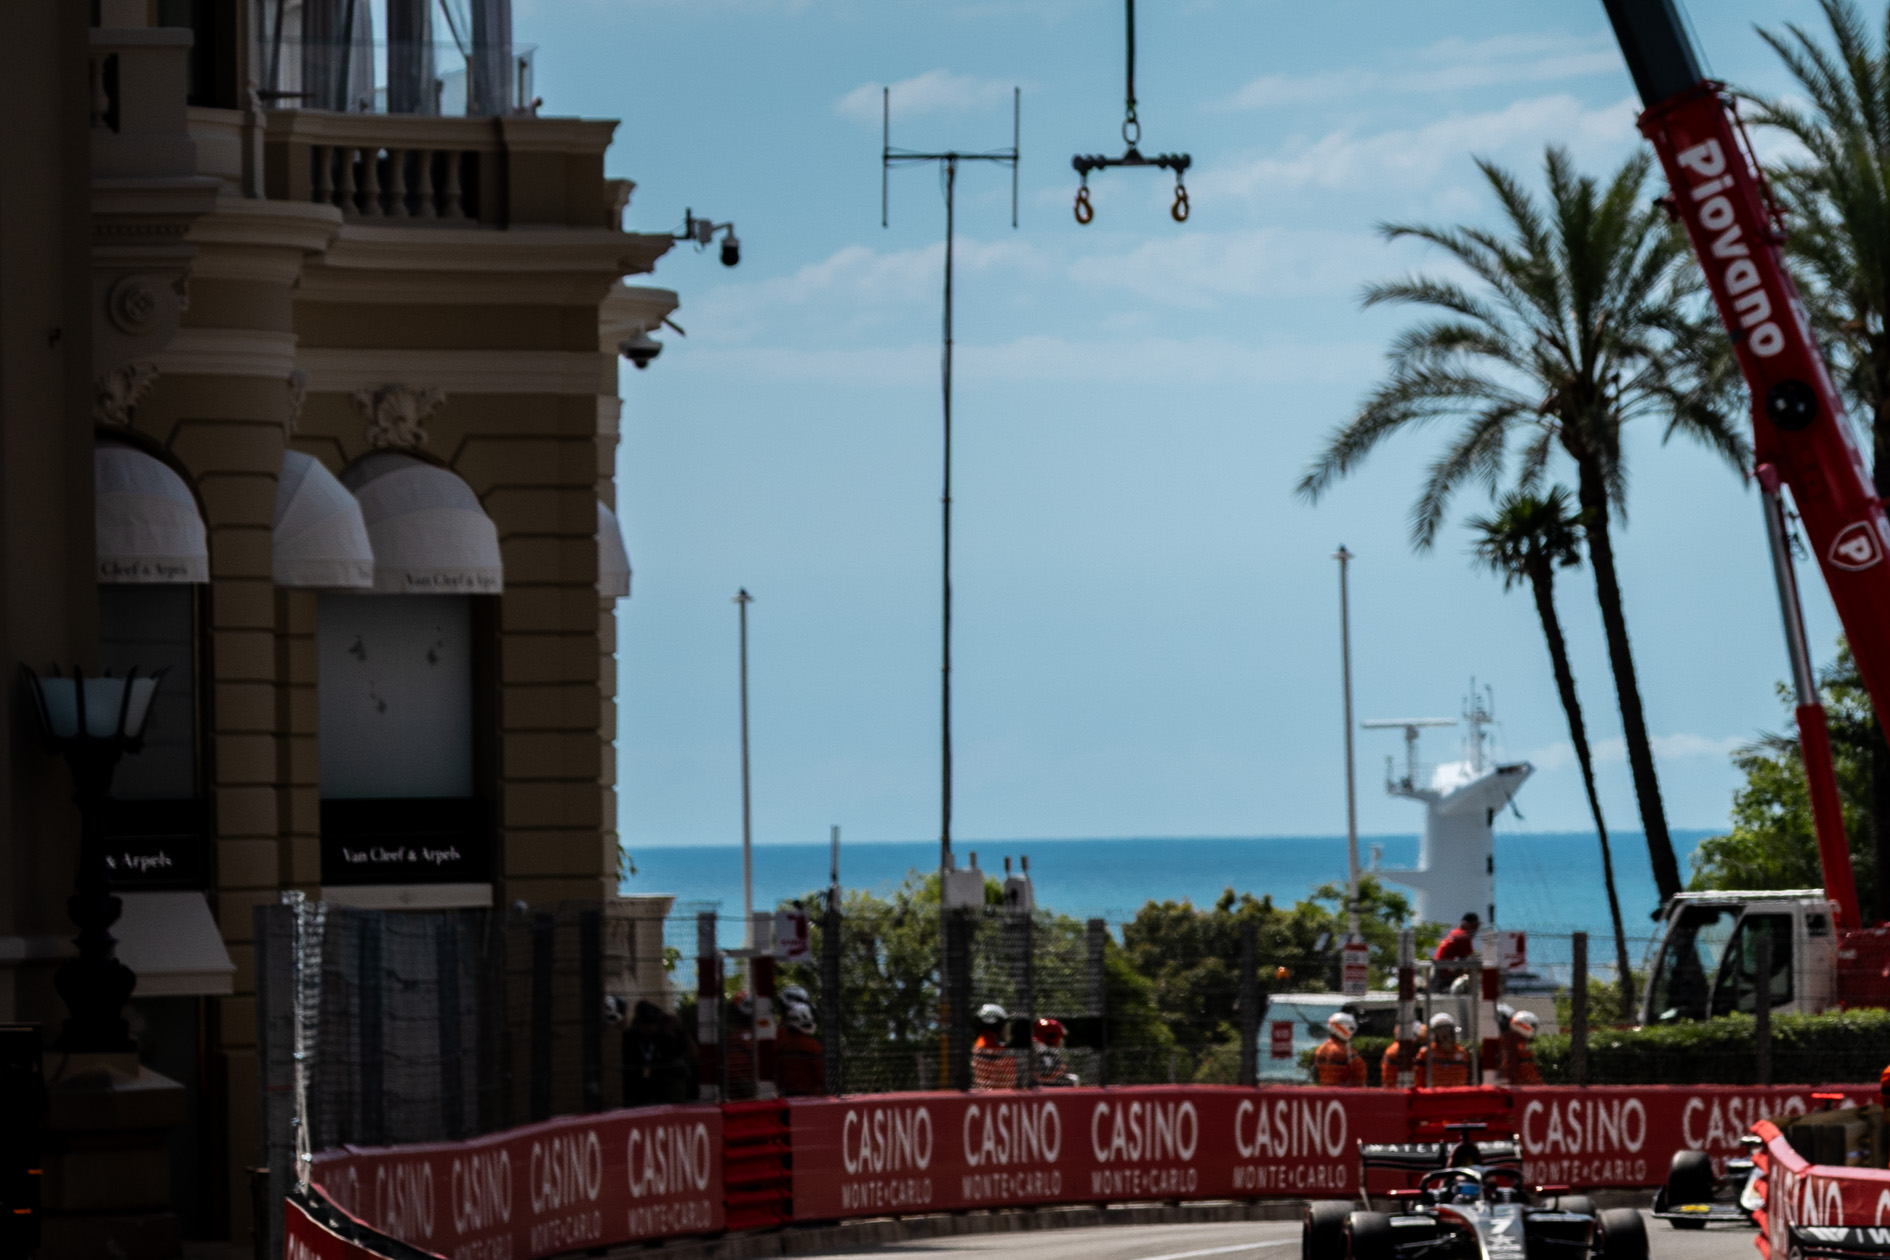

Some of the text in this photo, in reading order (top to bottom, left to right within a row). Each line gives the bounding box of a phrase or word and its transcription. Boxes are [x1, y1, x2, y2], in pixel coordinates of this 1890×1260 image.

[1677, 138, 1786, 358] Piovano
[122, 849, 173, 874] Arpels
[342, 845, 461, 866] Van Cleef & Arpels
[842, 1105, 933, 1176] CASINO
[963, 1100, 1061, 1168] CASINO
[1091, 1099, 1198, 1163] CASINO
[1234, 1098, 1347, 1159] CASINO
[1522, 1096, 1647, 1157] CASINO
[451, 1148, 512, 1235] CASINO
[529, 1128, 602, 1215] CASINO
[627, 1121, 710, 1199] CASINO
[1490, 1217, 1514, 1235] 7
